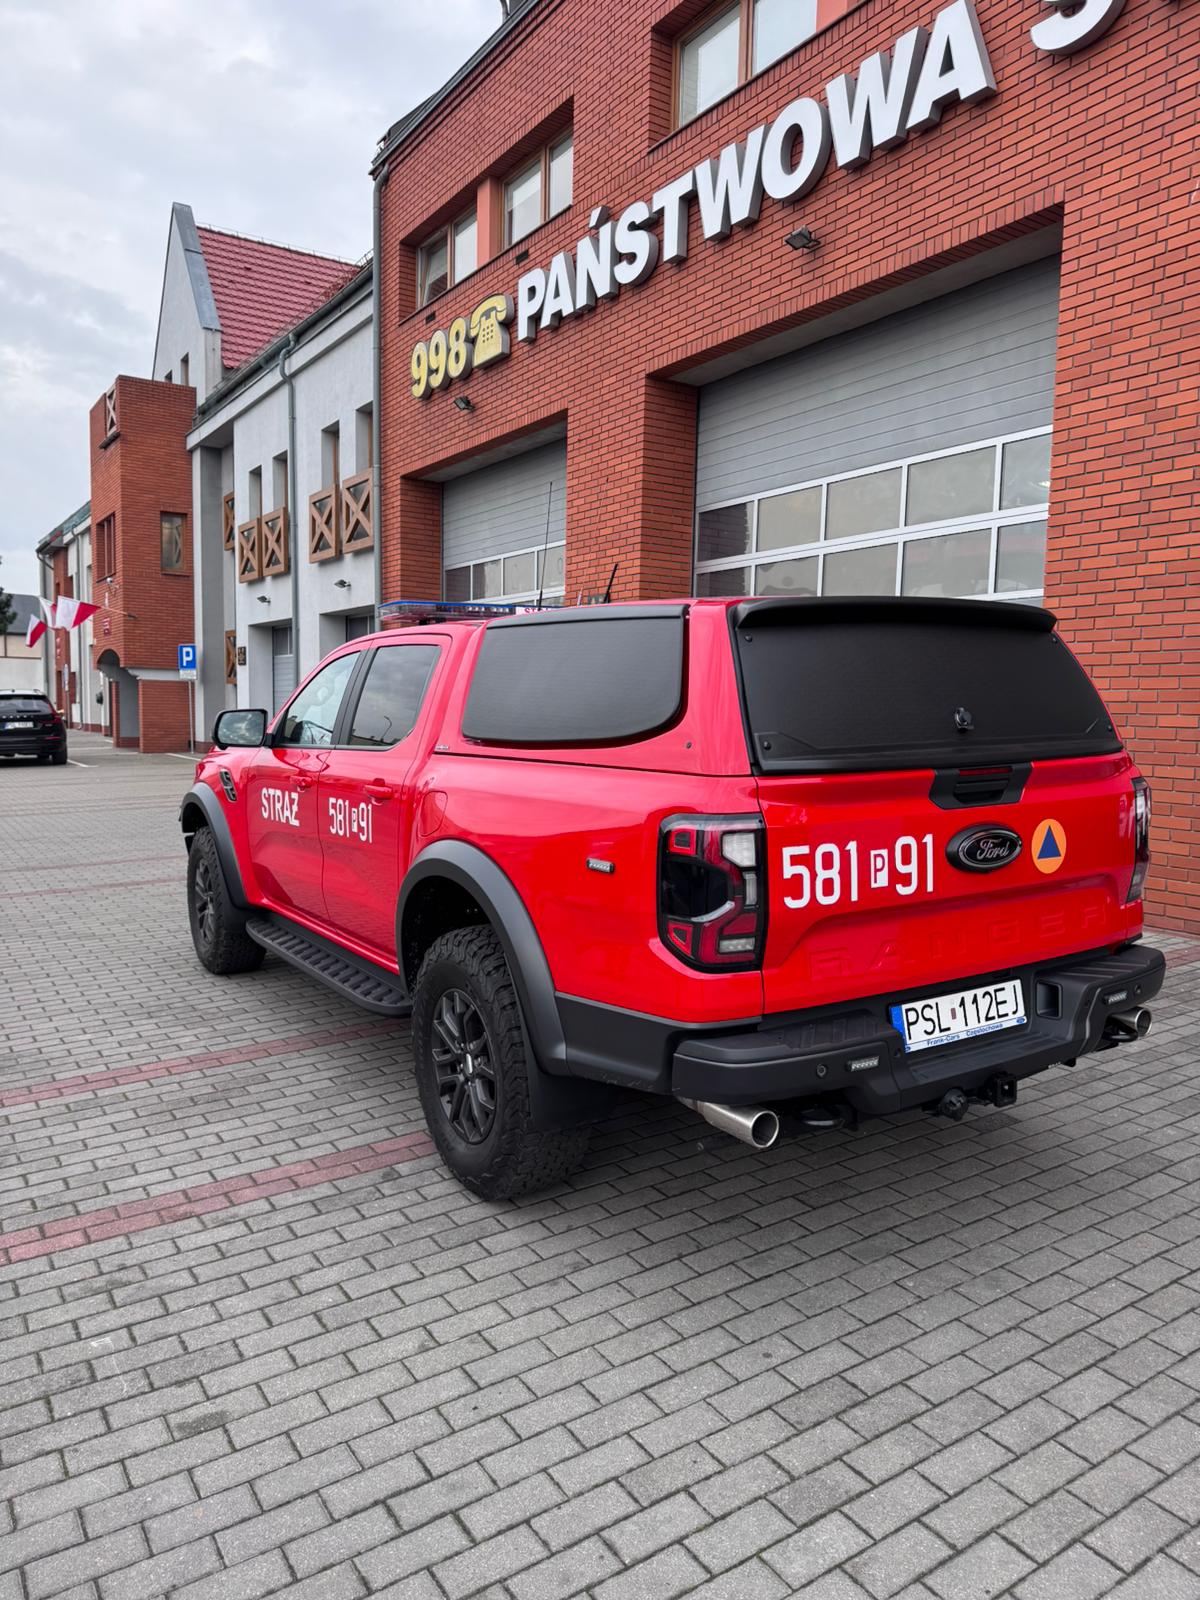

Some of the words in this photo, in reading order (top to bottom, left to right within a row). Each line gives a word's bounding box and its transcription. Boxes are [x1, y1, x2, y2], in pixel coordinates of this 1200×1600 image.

[412, 317, 468, 399] 998
[517, 0, 996, 342] PAŃSTWOWA
[183, 647, 193, 666] P
[976, 838, 1011, 860] Ford
